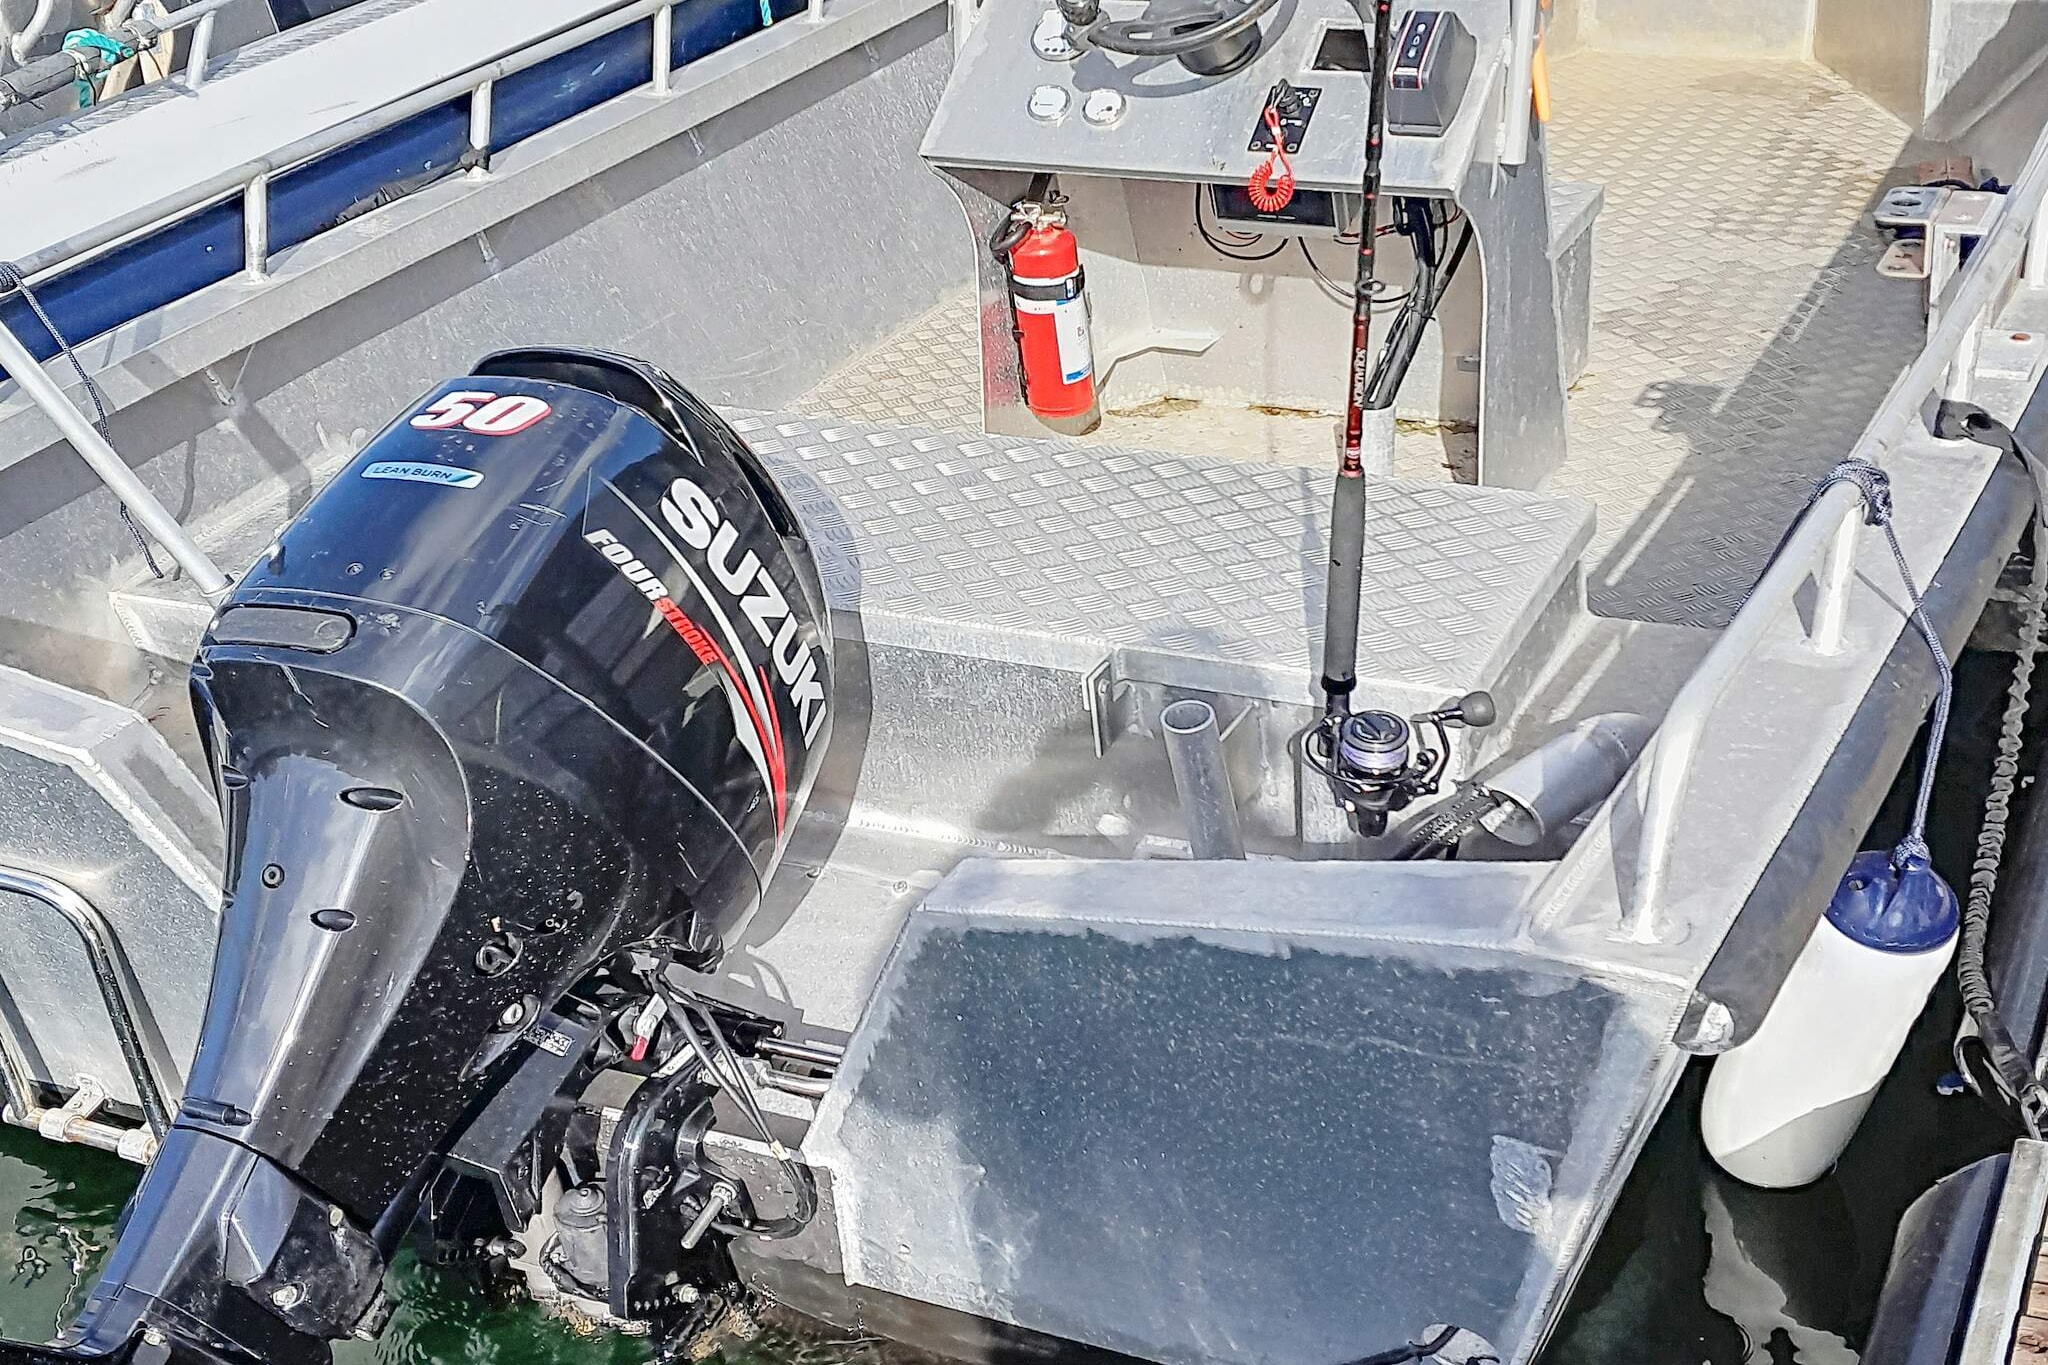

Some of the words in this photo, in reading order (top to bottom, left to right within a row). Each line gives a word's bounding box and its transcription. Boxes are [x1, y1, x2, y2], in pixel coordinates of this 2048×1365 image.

[1353, 347, 1366, 408] SQUADRON
[409, 391, 552, 436] 50
[373, 466, 410, 474] LEAN
[411, 468, 452, 479] BURN
[583, 528, 669, 601] FOUR
[653, 597, 719, 665] STROKE
[660, 477, 828, 750] SUZUKI
